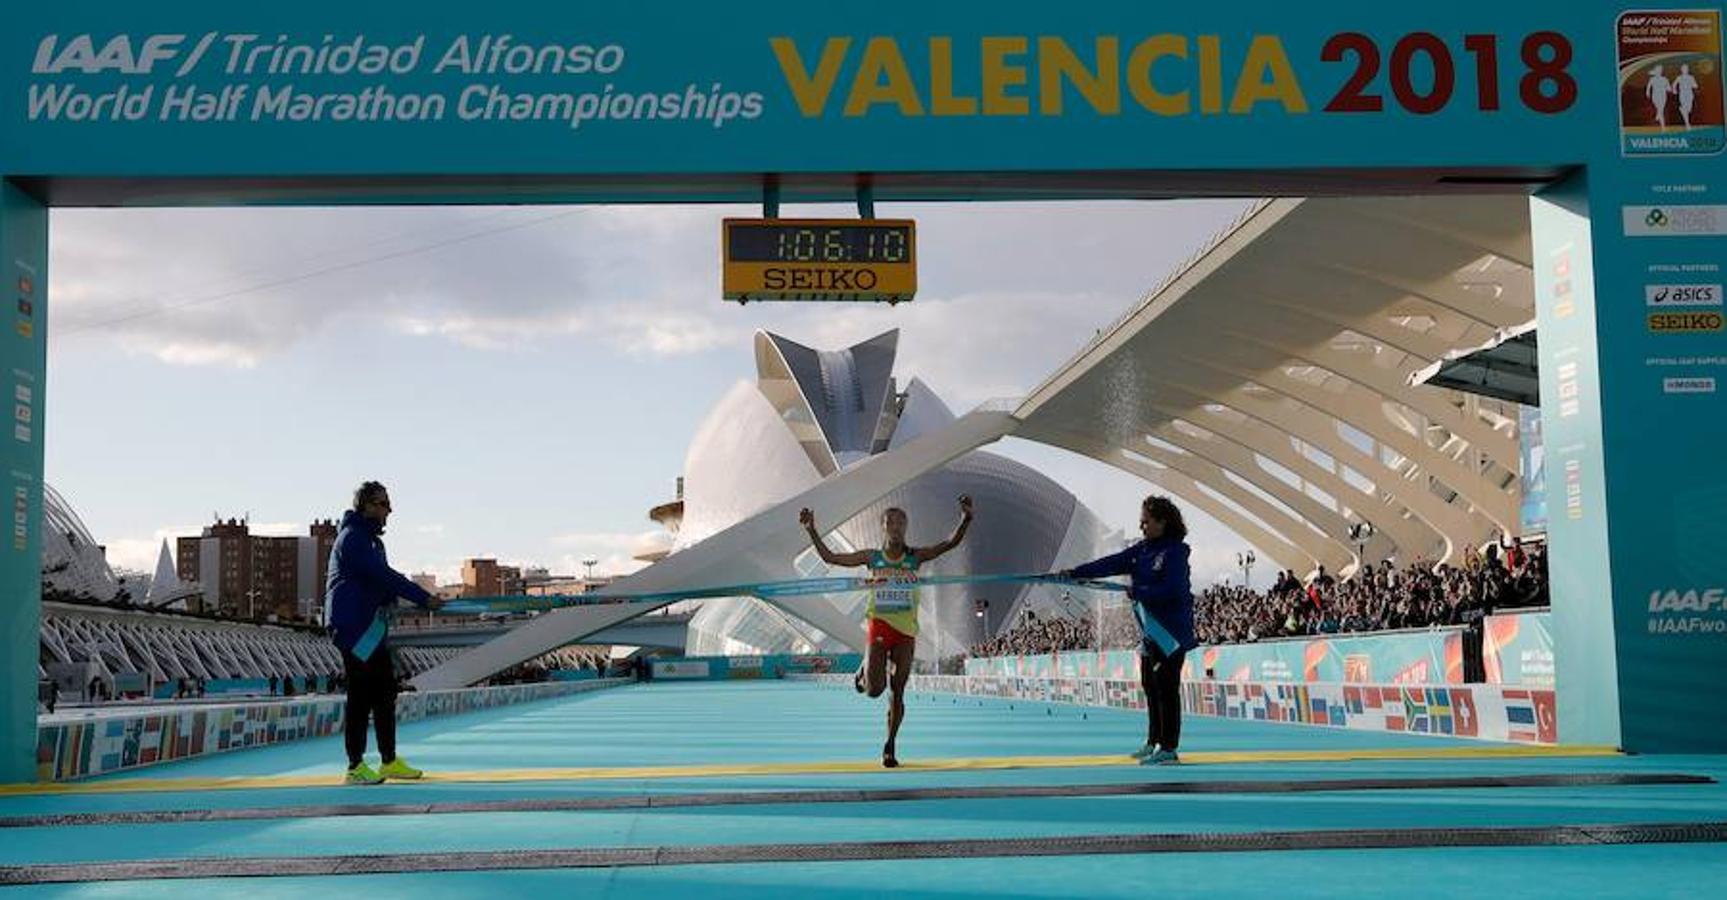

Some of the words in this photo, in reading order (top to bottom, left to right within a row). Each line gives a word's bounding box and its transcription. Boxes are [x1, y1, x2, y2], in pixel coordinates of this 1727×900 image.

[223, 34, 426, 74] Trinidad
[433, 34, 625, 74] Alfonso
[771, 33, 1309, 117] VALENCIA
[1320, 31, 1578, 114] 2018
[28, 84, 153, 121] World
[159, 85, 248, 121] Half
[250, 85, 446, 121] Marathon
[457, 84, 763, 128] Championships
[1629, 137, 1689, 149] VALENCIA
[763, 268, 878, 291] SEIKO
[1650, 313, 1721, 330] SEIKO
